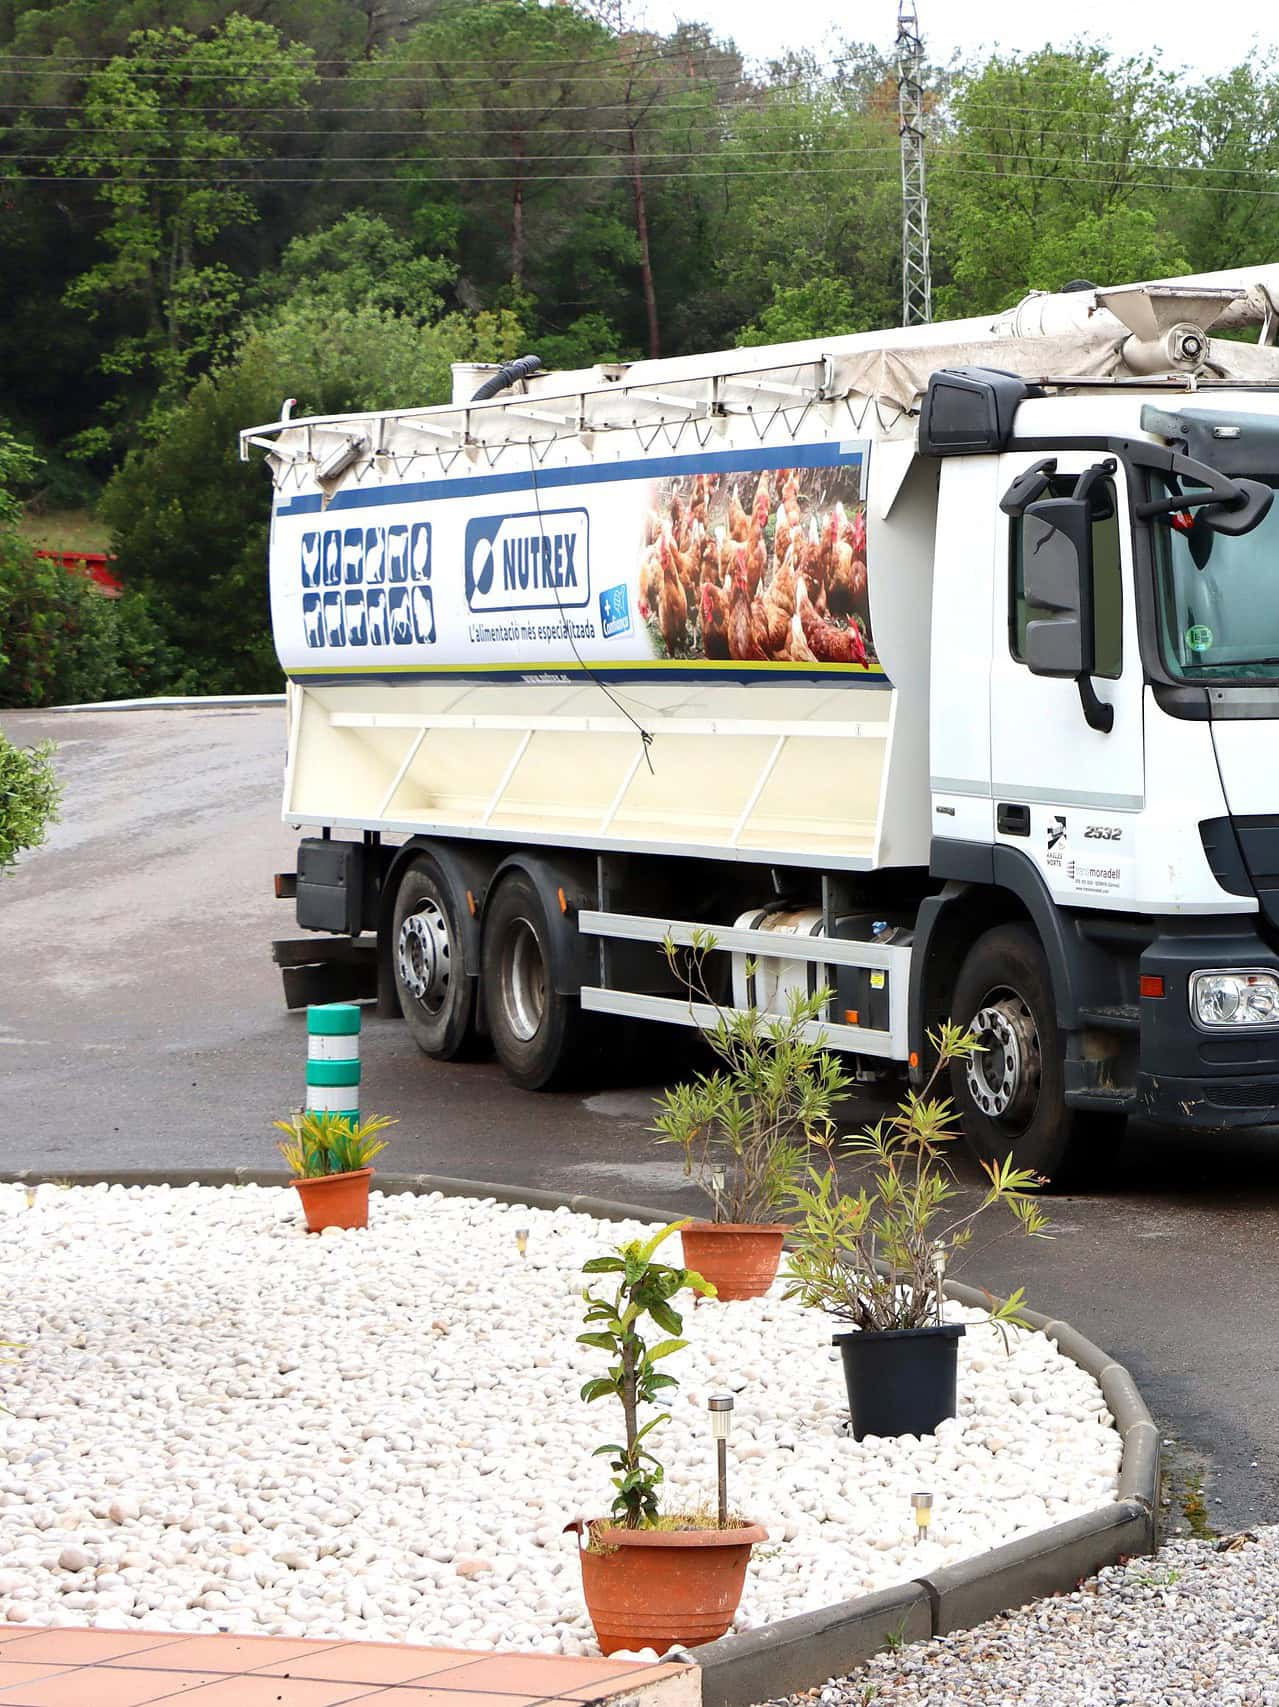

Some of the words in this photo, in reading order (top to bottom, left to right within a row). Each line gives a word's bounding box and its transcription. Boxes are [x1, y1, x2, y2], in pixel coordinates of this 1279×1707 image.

[503, 533, 578, 591] NUTREX
[468, 621, 520, 643] L'alimentació
[521, 620, 537, 641] més
[538, 619, 596, 644] especialitzada
[1084, 826, 1122, 841] 2532
